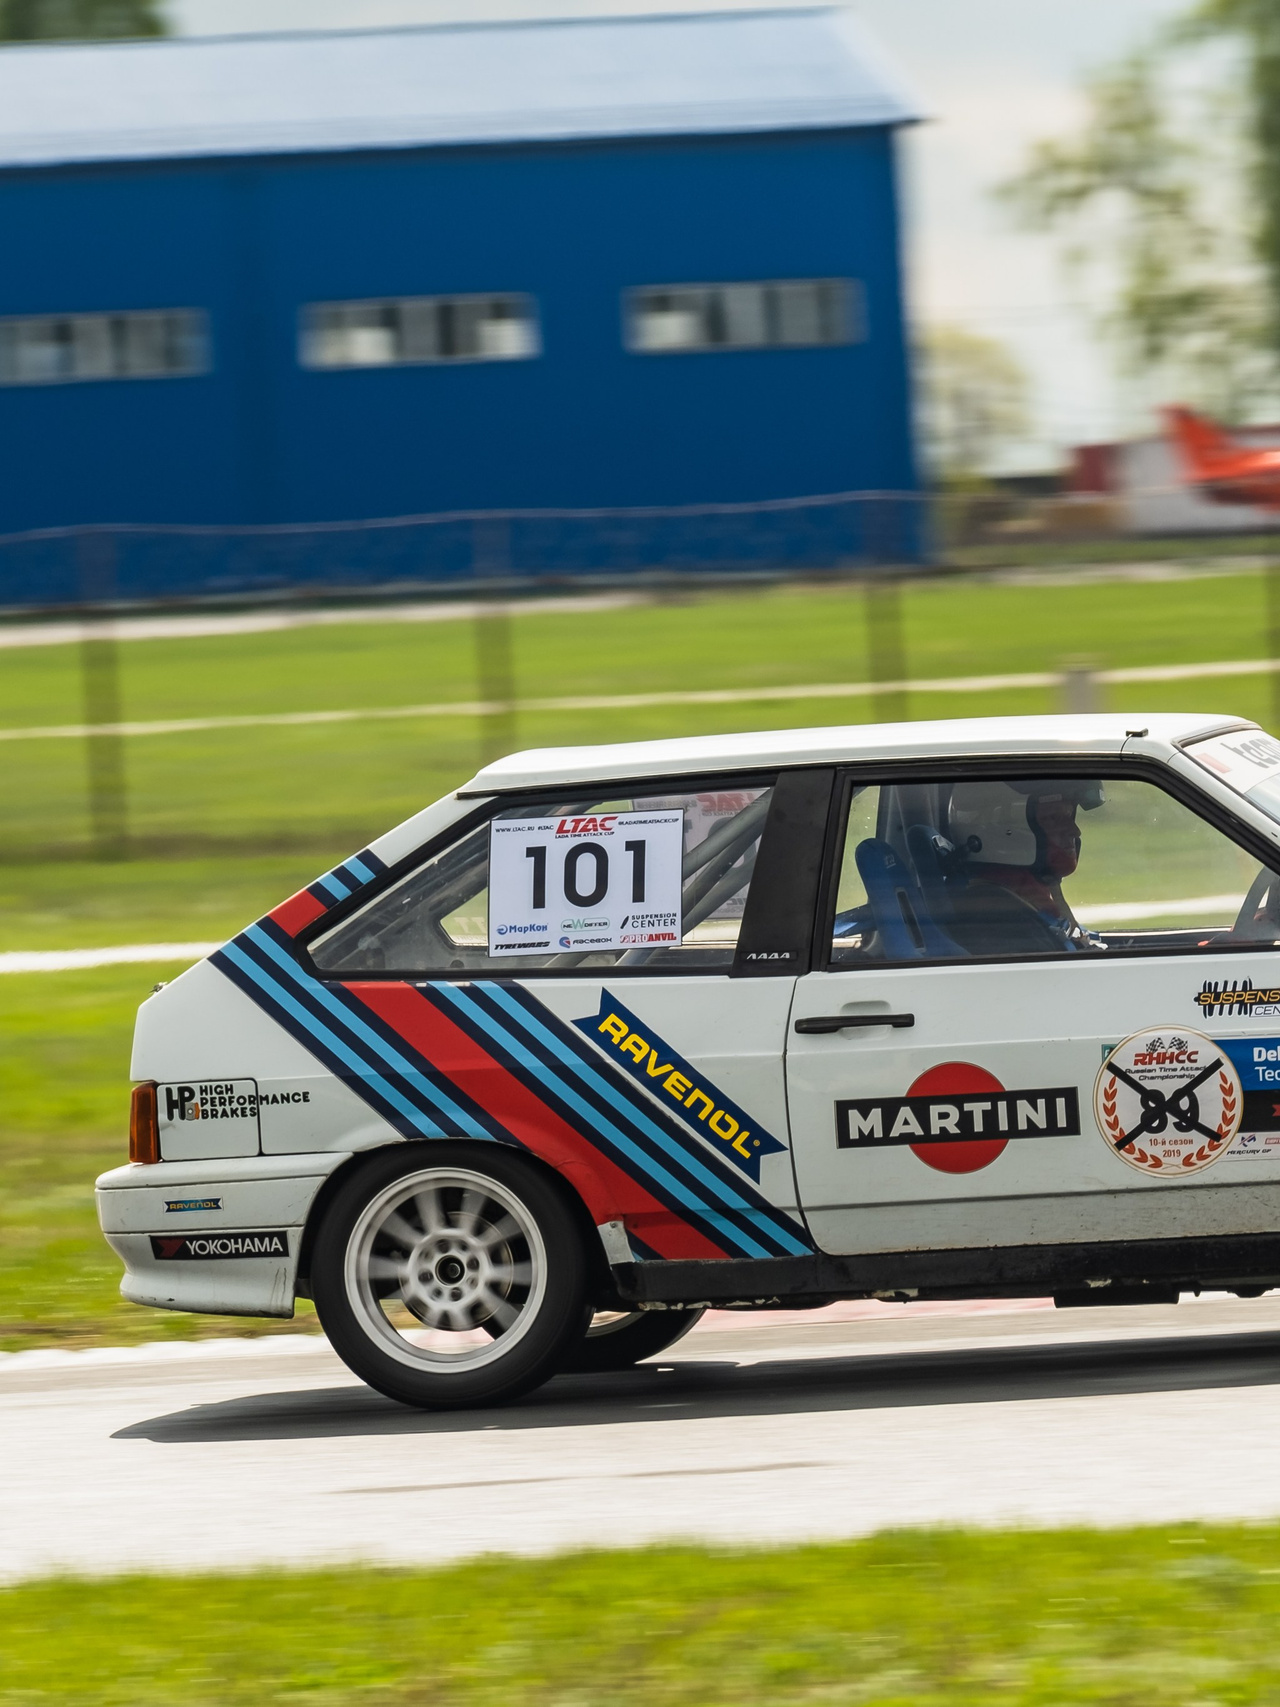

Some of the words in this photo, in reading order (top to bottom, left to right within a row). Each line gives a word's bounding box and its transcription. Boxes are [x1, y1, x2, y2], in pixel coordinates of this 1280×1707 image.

[555, 816, 619, 834] LTAC
[525, 839, 647, 910] 101
[631, 912, 677, 920] SUSPENSION
[631, 918, 677, 929] CENTER
[494, 941, 551, 950] TYREWARS
[1133, 1050, 1199, 1066] RHHCC
[1138, 1073, 1196, 1081] Championship
[199, 1083, 234, 1096] HIGH
[598, 1013, 751, 1159] RAVENOL
[200, 1091, 311, 1108] PERFORMANCE
[200, 1106, 258, 1120] BRAKES
[847, 1097, 1067, 1140] MARTINI
[1149, 1138, 1167, 1146] 10-й
[1168, 1138, 1194, 1146] сезон
[1162, 1149, 1181, 1158] 2019
[1226, 1148, 1261, 1156] MERCURY
[169, 1200, 217, 1210] RAVENOL
[185, 1236, 284, 1256] YOKOHAMA
